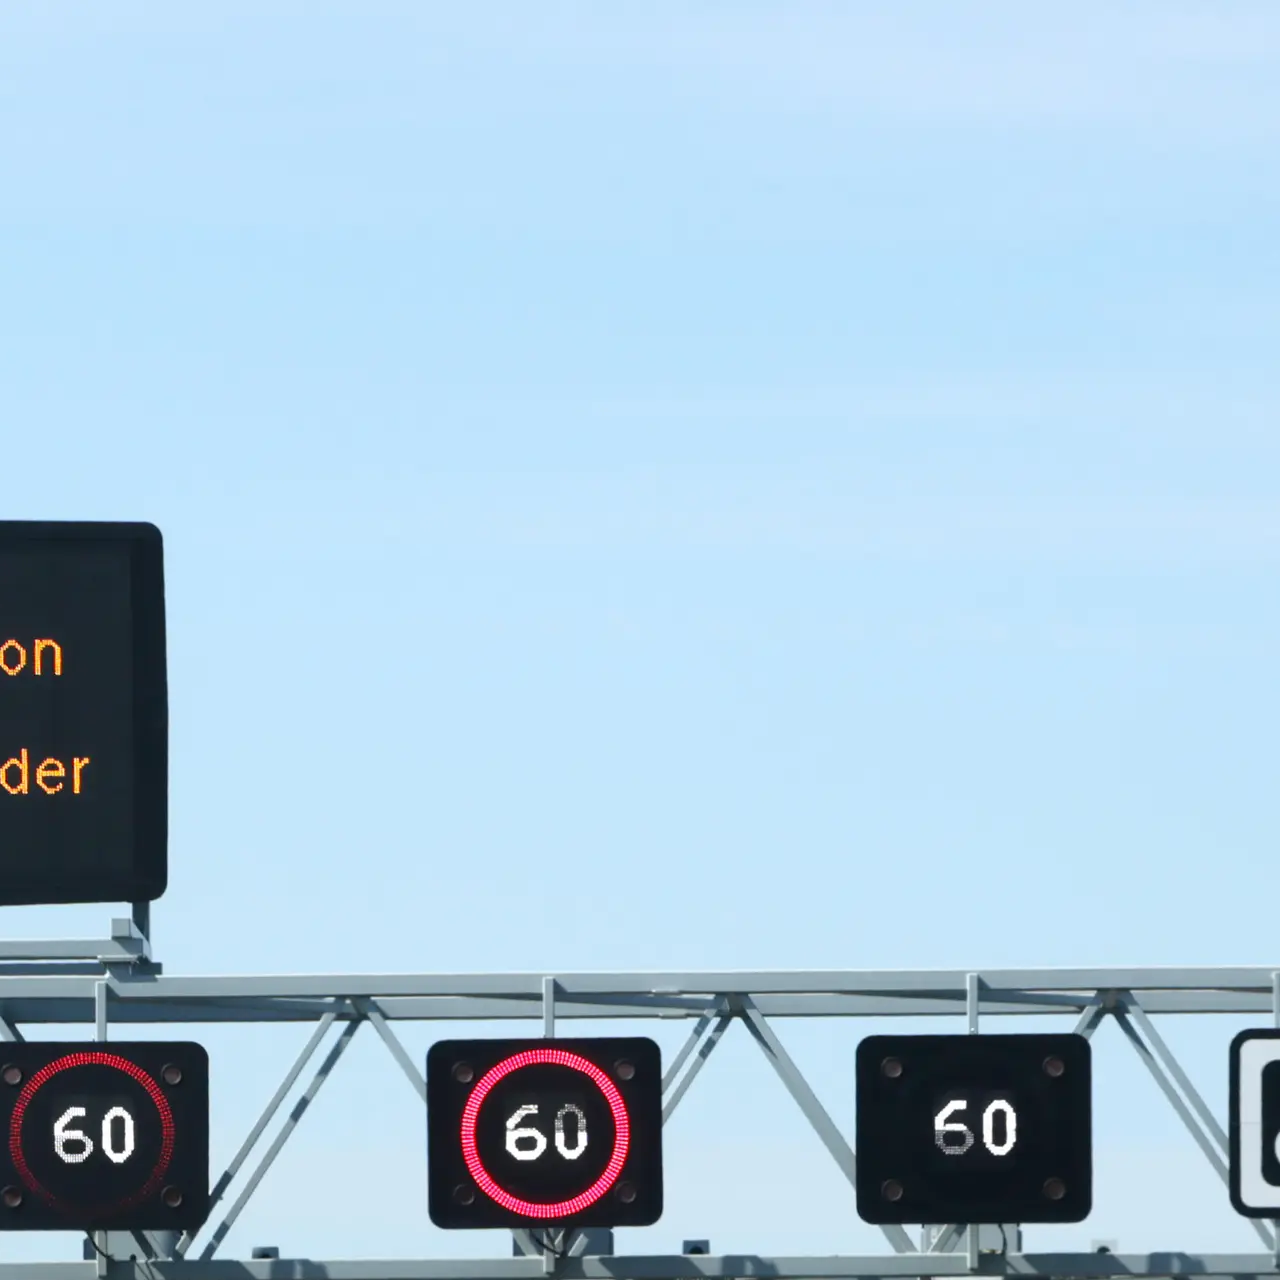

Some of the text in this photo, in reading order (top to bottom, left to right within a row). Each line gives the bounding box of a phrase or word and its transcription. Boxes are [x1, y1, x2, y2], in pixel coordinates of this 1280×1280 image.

[53, 1107, 135, 1163] 60
[505, 1104, 588, 1161] 60
[934, 1099, 1017, 1156] 60
